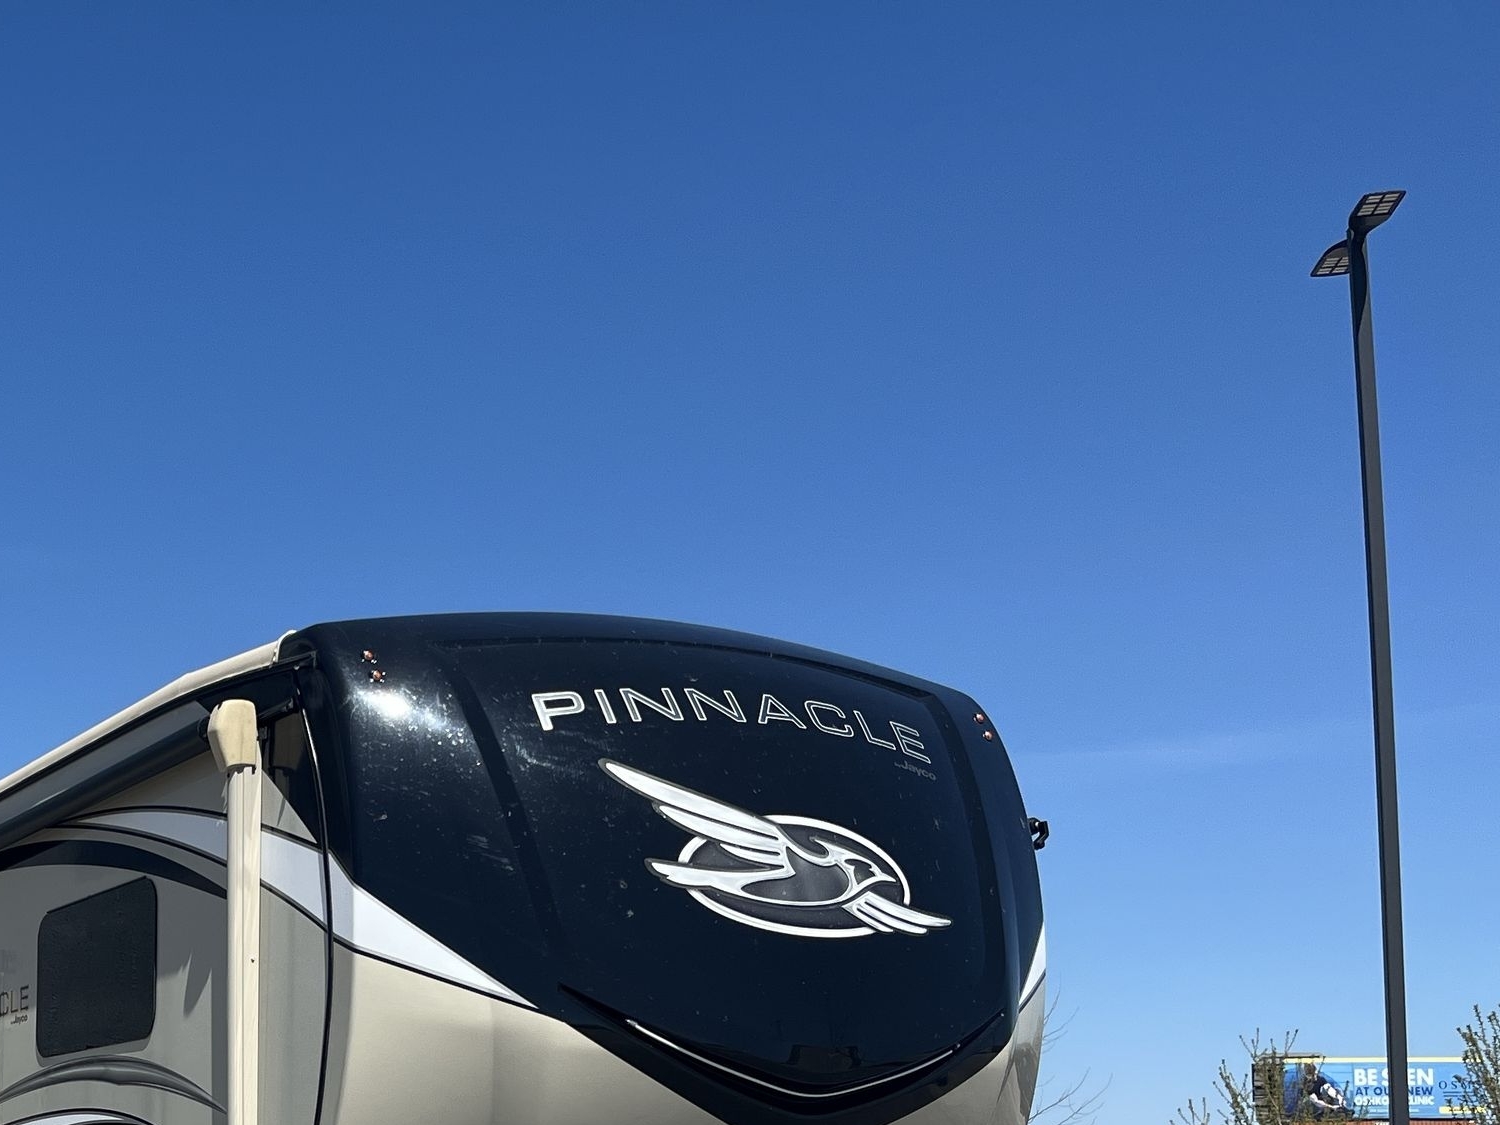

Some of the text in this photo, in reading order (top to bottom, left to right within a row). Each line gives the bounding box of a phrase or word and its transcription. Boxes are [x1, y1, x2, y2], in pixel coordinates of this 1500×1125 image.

[531, 687, 932, 764] PINNACLE
[901, 759, 937, 781] Jayco
[1354, 1068, 1434, 1086] BE SEN
[1355, 1086, 1369, 1096] AT
[1354, 1095, 1435, 1106] OSHKO LINIC
